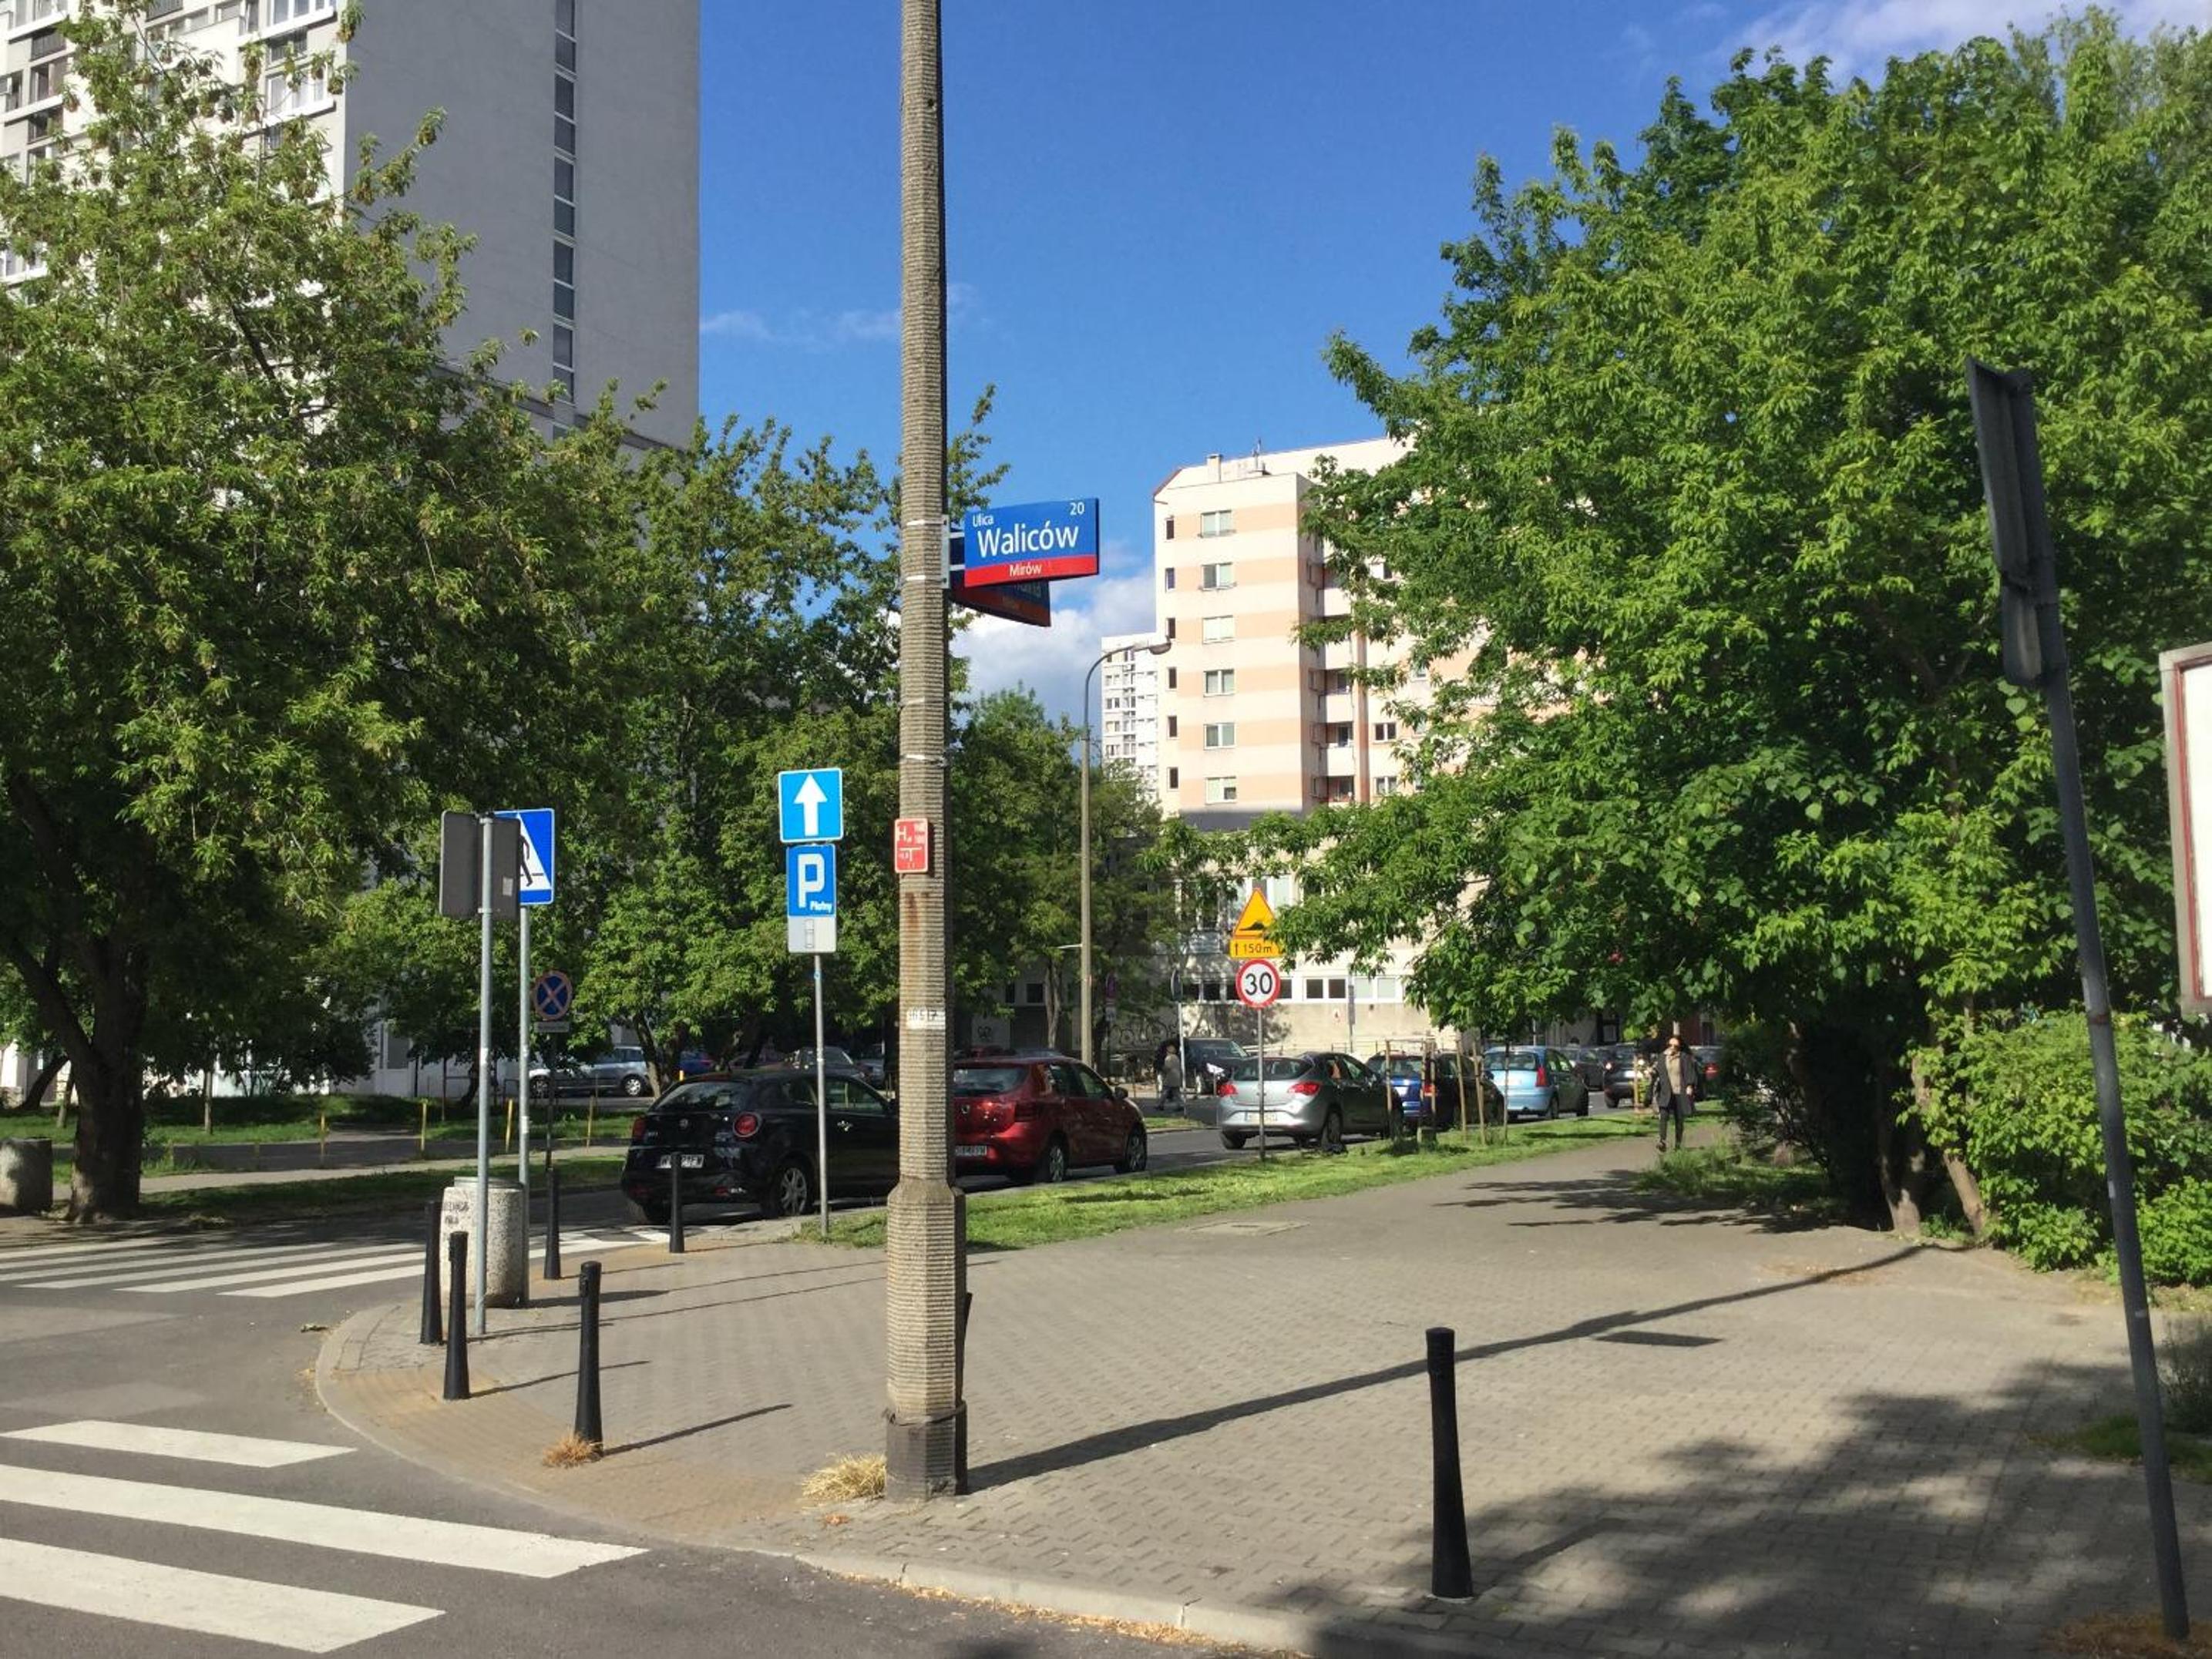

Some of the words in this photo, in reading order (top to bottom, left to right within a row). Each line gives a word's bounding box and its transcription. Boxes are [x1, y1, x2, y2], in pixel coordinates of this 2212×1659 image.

[1070, 502, 1085, 515] 20
[972, 513, 994, 527] Ulica
[977, 520, 1079, 558] Waliców
[1009, 563, 1042, 577] Mirów
[798, 853, 825, 908] P
[1245, 972, 1272, 996] 30
